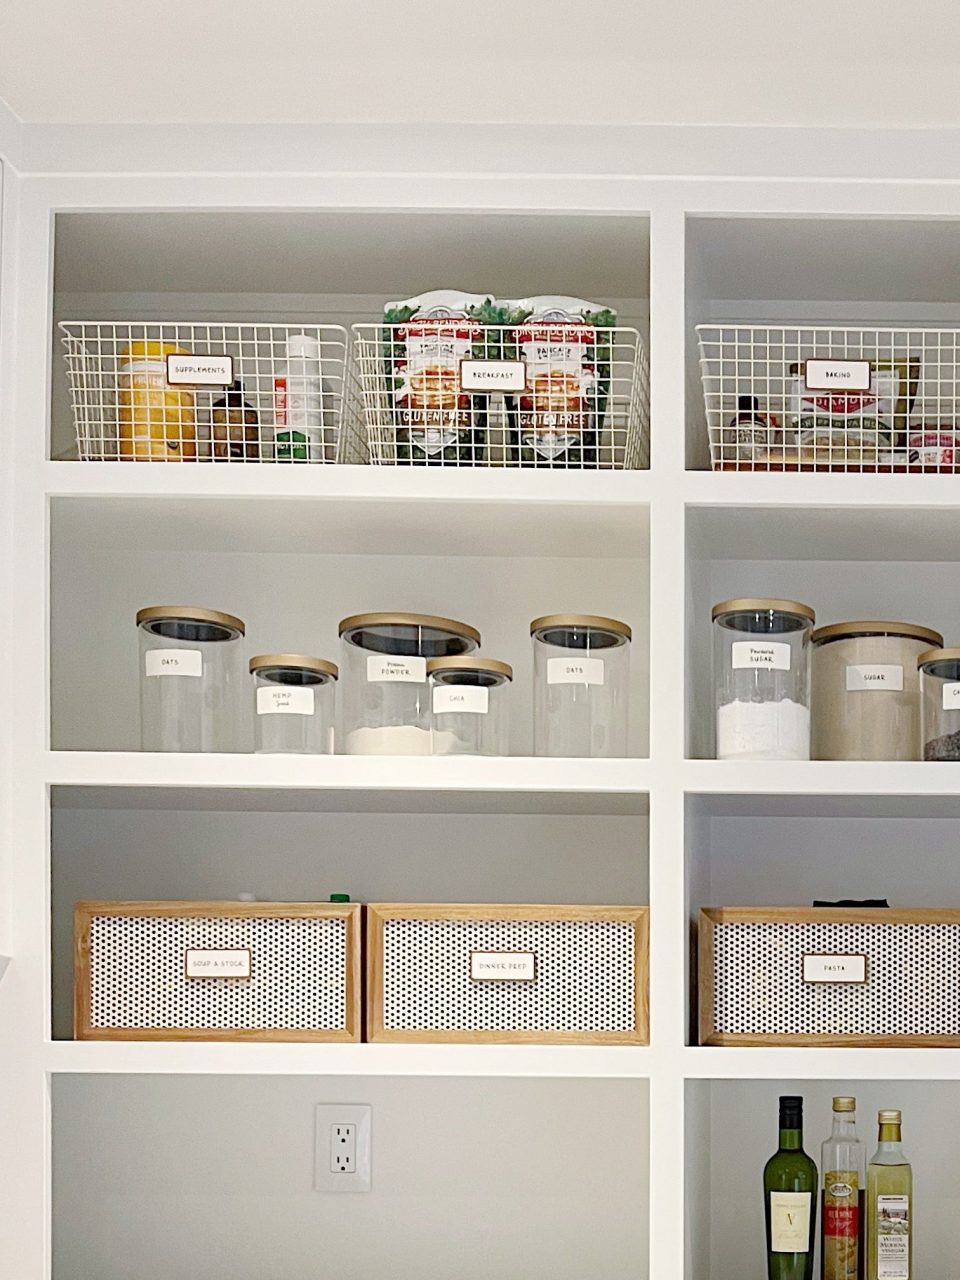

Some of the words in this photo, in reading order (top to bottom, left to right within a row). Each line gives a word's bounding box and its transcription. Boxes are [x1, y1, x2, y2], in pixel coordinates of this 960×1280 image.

[175, 365, 226, 376] SUPPLEMENTS
[472, 371, 515, 380] BREAKFAST
[402, 410, 440, 422] GLUTEN
[559, 413, 586, 426] FREE
[161, 658, 179, 666] OATS
[381, 668, 411, 676] POWDER
